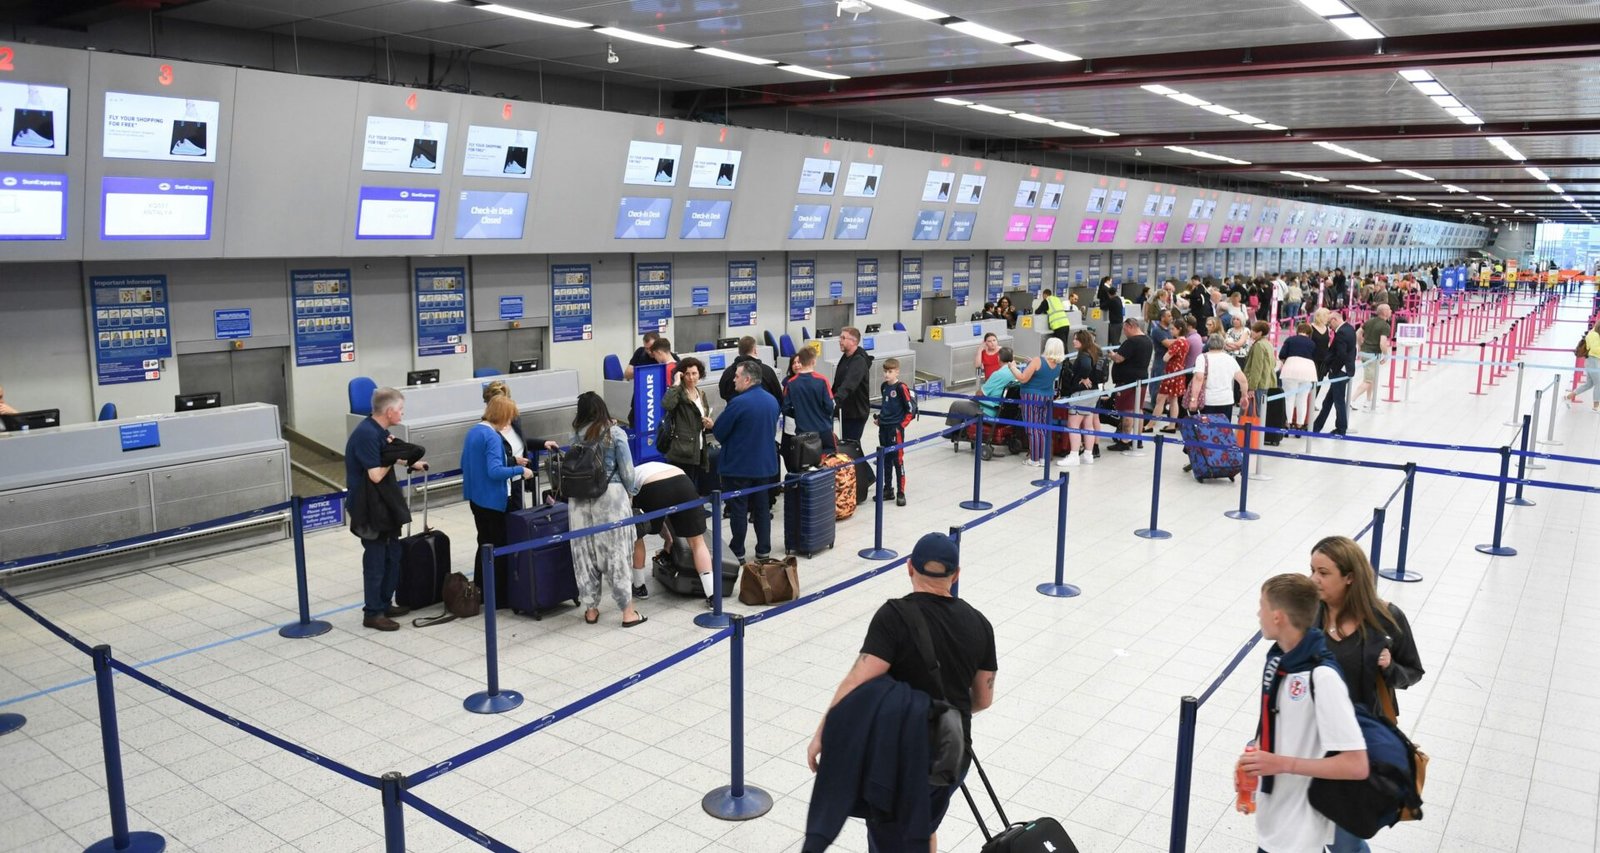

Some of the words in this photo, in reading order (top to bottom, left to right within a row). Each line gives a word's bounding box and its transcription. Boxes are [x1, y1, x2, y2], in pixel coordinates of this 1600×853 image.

[0, 48, 14, 71] 2
[158, 64, 173, 85] 3
[405, 92, 417, 111] 4
[498, 207, 513, 215] Desk
[649, 211, 660, 219] Desk
[480, 216, 502, 224] Closed
[635, 218, 651, 226] Closed
[309, 500, 330, 509] NOTICE
